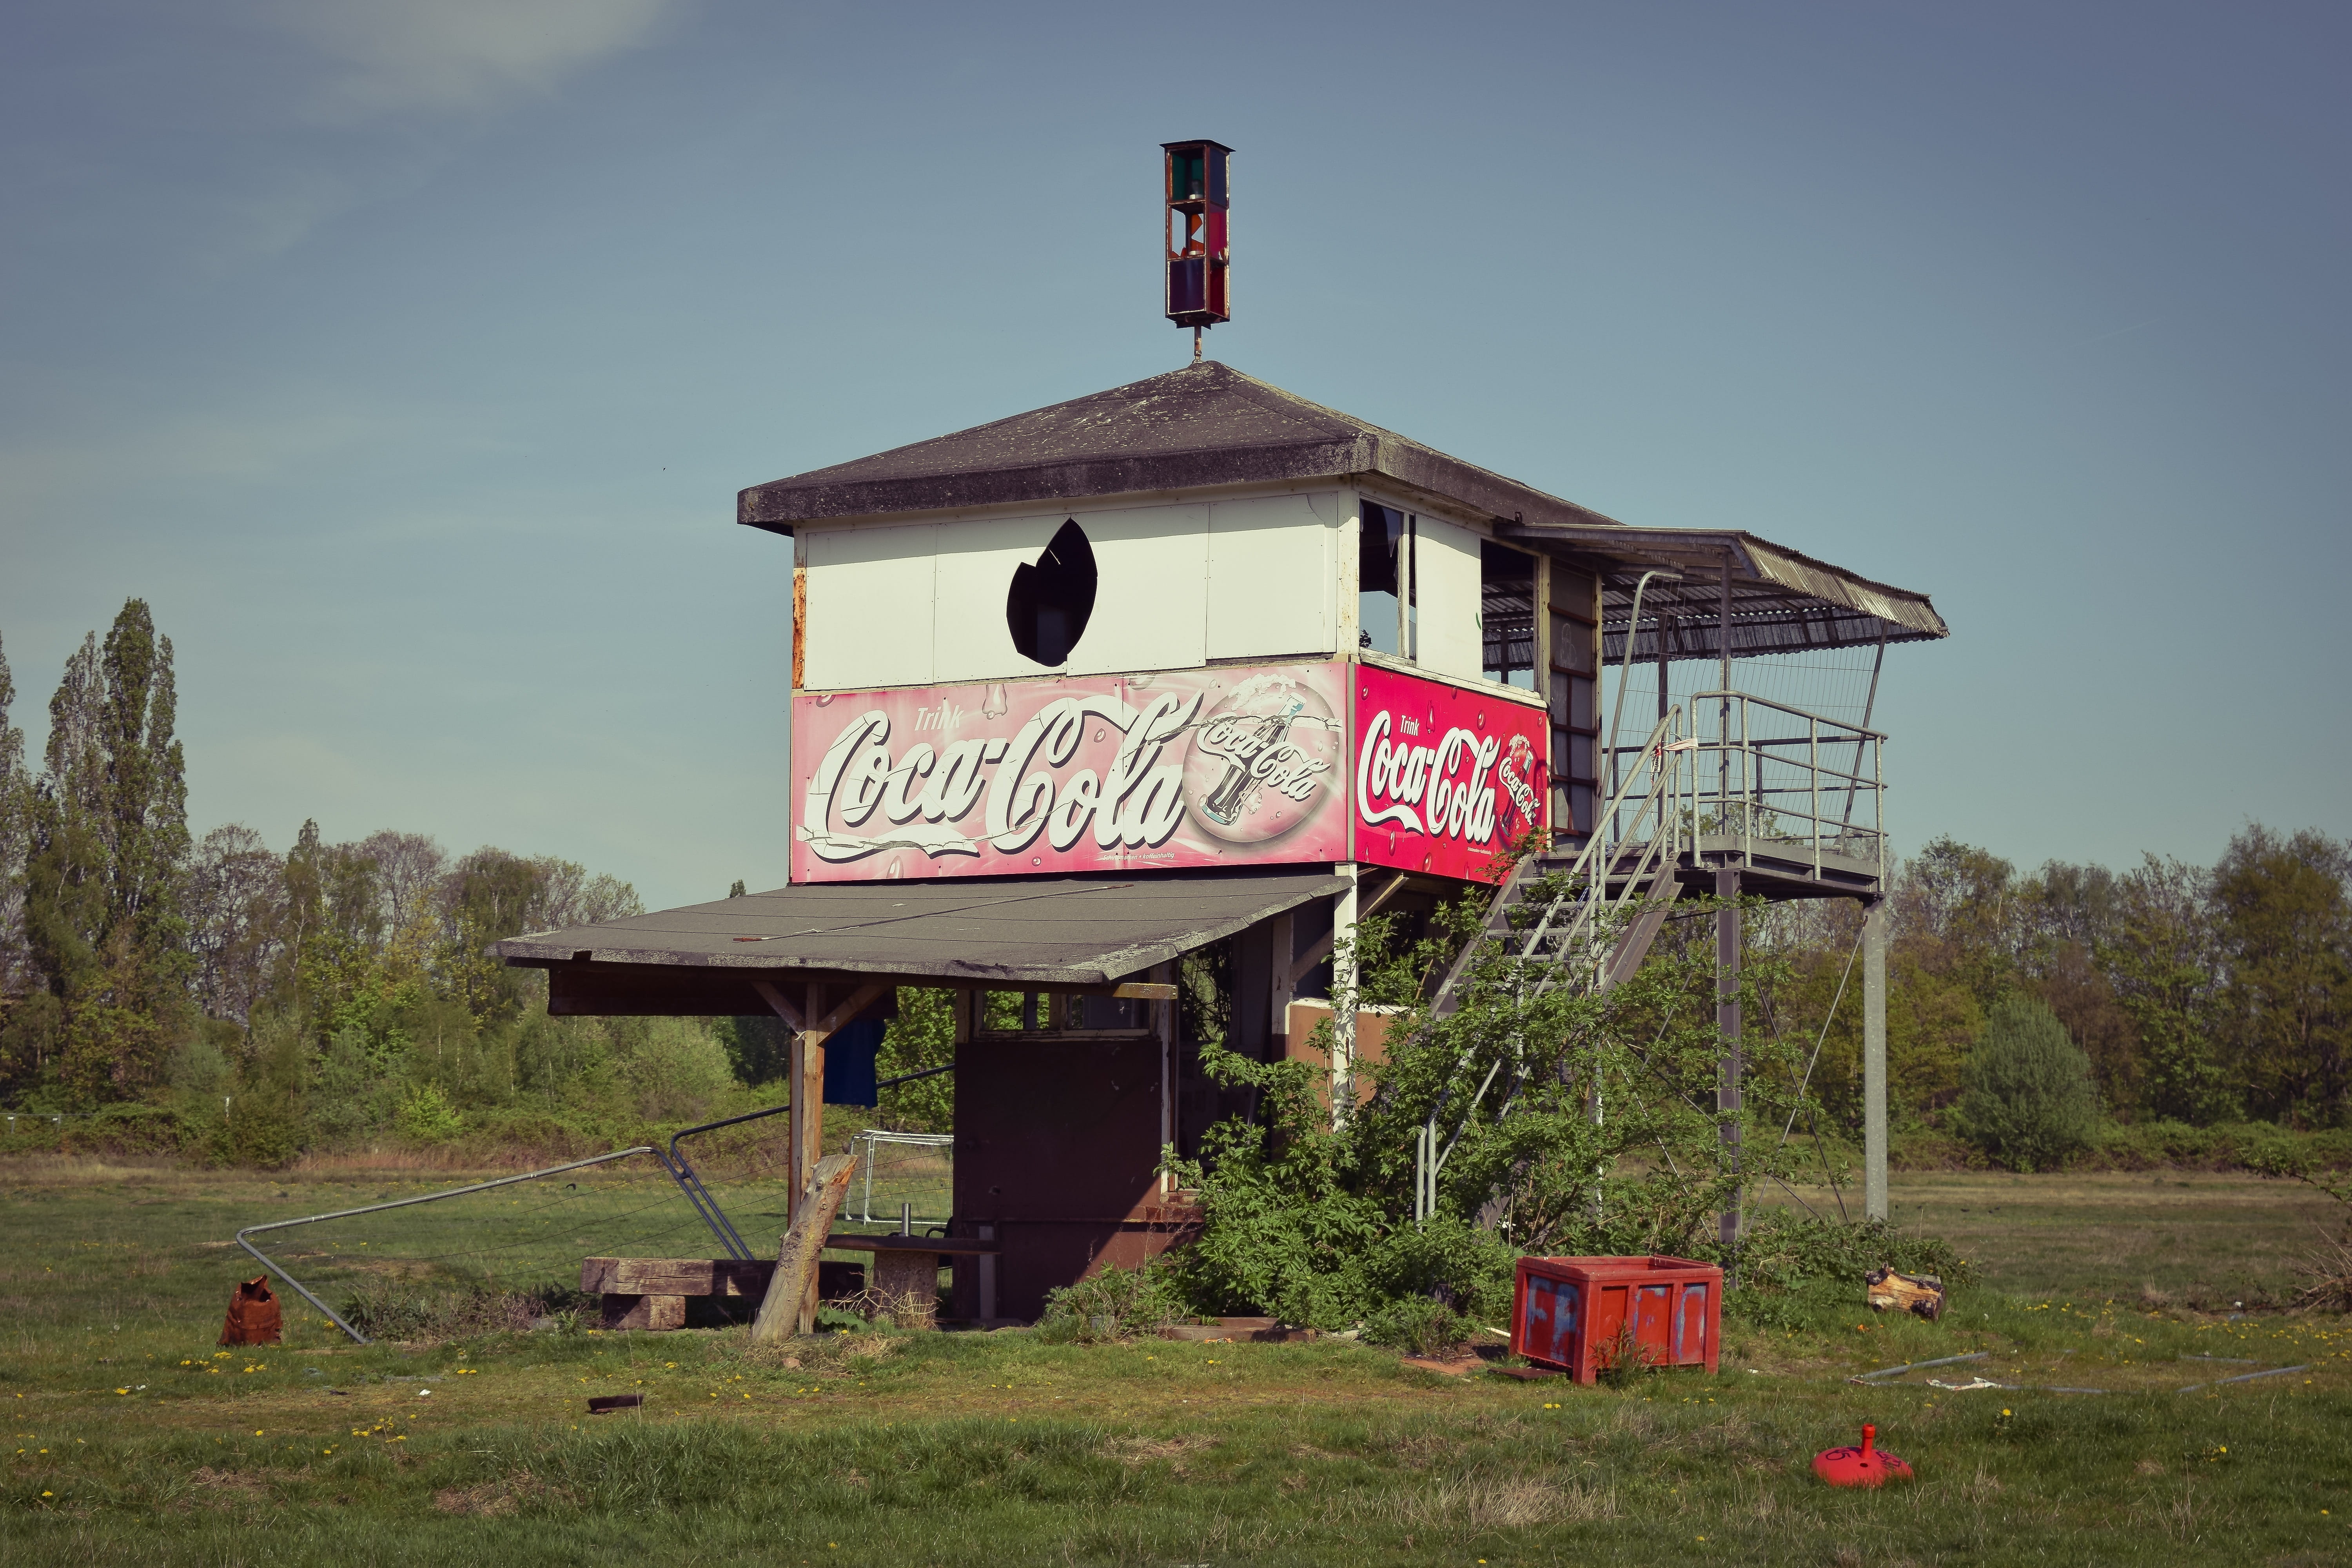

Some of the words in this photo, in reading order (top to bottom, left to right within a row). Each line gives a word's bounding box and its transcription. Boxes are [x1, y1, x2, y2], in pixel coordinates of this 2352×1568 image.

[914, 705, 965, 731] Trink
[1197, 711, 1331, 802] Coca-Cola
[1400, 715, 1420, 736] Trink
[804, 690, 1203, 863] Coca-Cola
[1357, 710, 1501, 846] Coca-Cola
[1499, 757, 1541, 826] Coca-Cola
